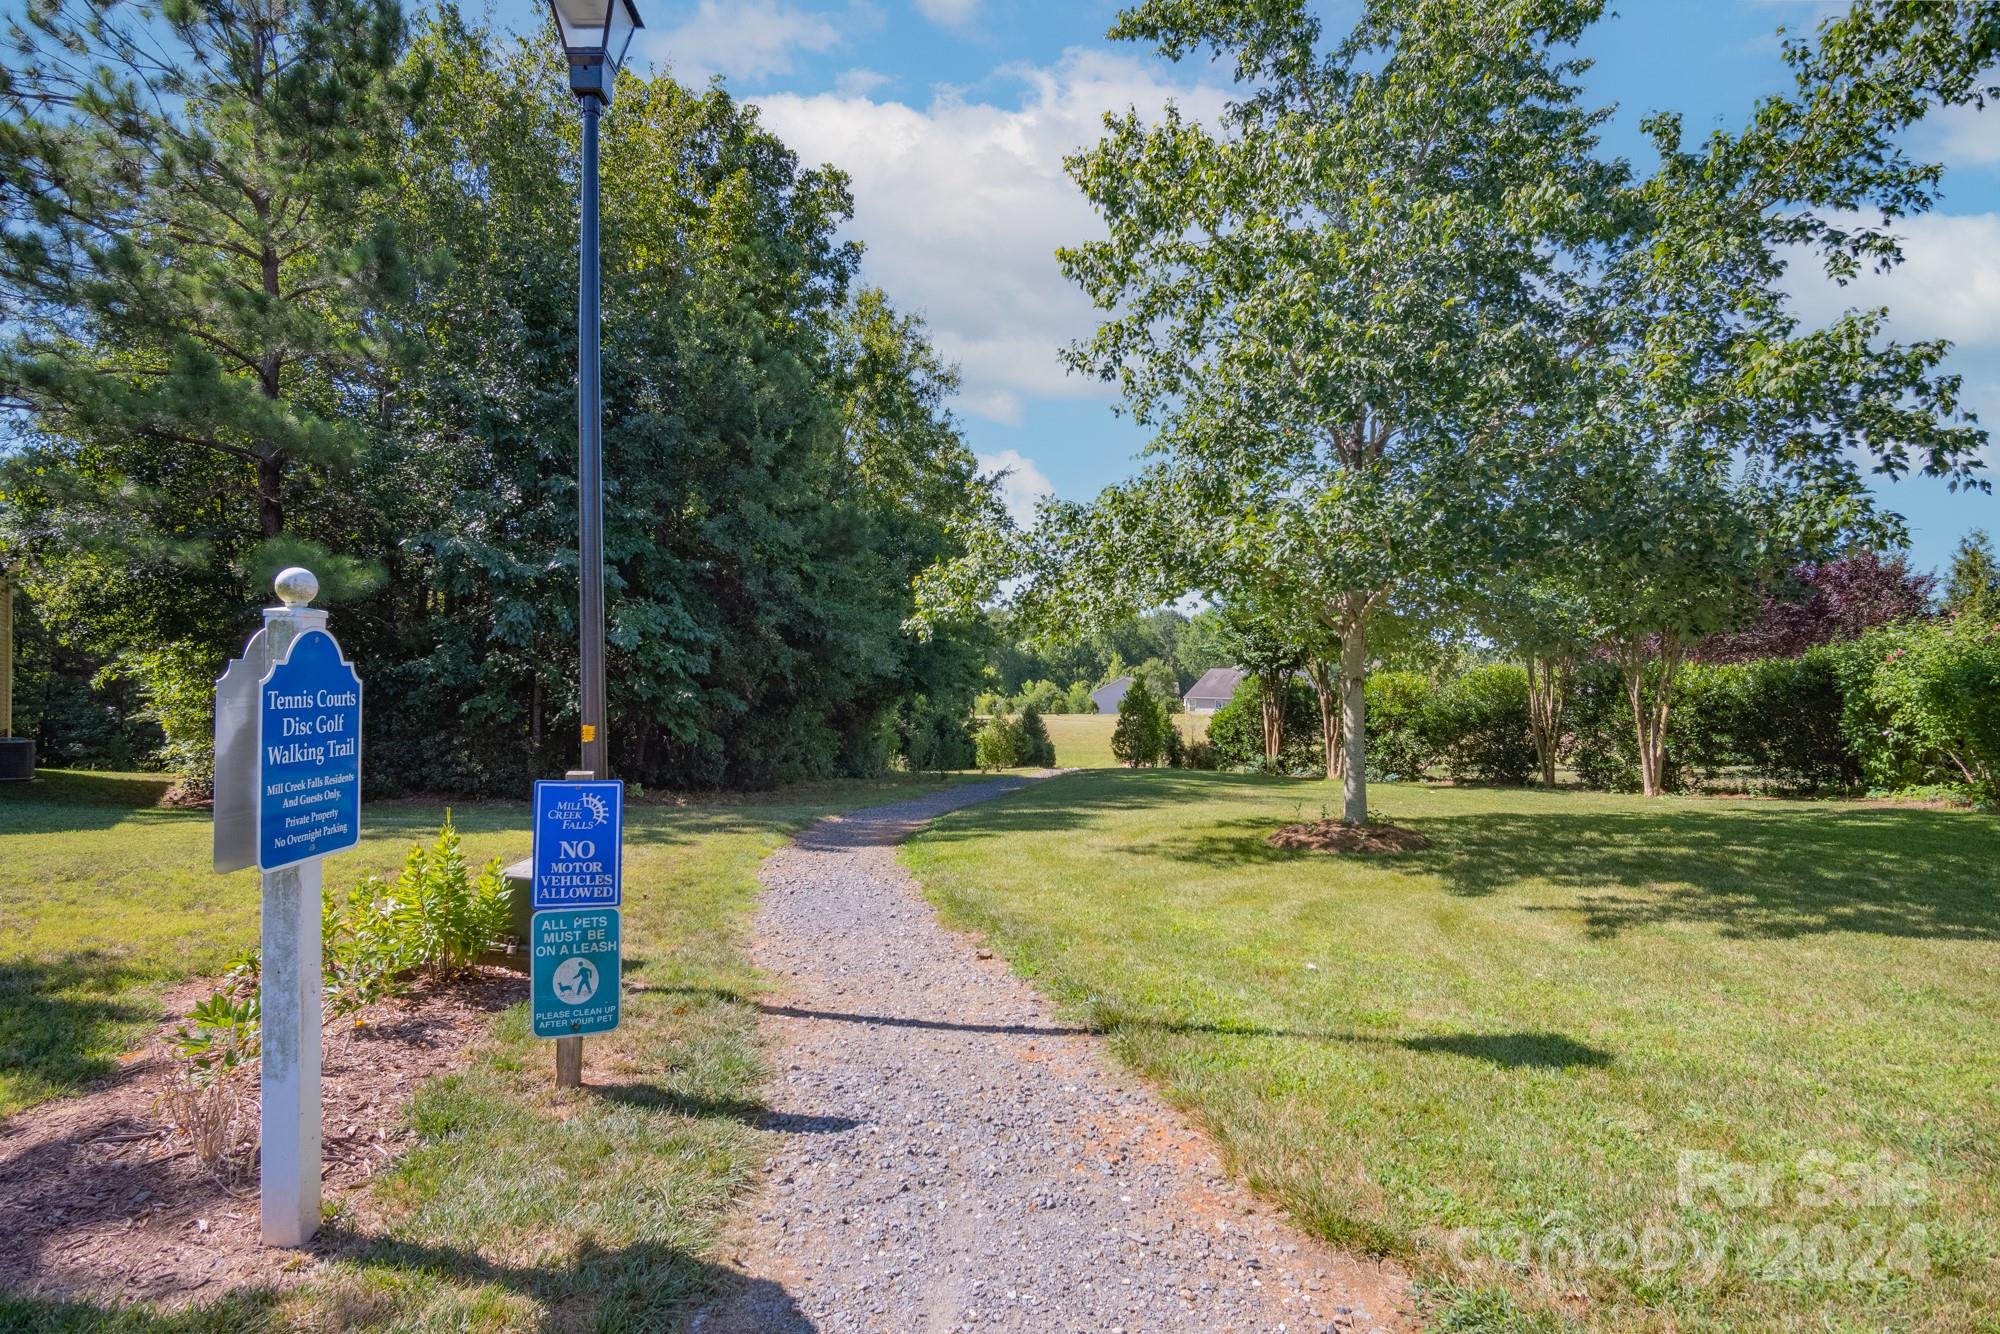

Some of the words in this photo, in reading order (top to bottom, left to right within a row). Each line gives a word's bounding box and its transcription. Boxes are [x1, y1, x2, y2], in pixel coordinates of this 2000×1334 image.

[267, 689, 313, 710] Tennis
[317, 689, 356, 707] Courts
[282, 716, 312, 736] Disc
[316, 714, 344, 733] Golf
[267, 742, 325, 766] Walking
[327, 737, 354, 758] Trail
[267, 783, 284, 796] Mill
[285, 780, 306, 792] Creek
[307, 777, 323, 789] Falls
[325, 773, 354, 784] Residents
[282, 796, 298, 808] And
[300, 793, 323, 804] Guests
[557, 801, 582, 810] MILL
[285, 815, 309, 828] Private
[311, 809, 339, 822] Property
[548, 810, 583, 819] CREEK
[562, 820, 595, 829] FALLS
[274, 838, 285, 848] No
[287, 828, 322, 845] Overnight
[323, 823, 348, 836] Parking
[559, 840, 595, 859] NO
[551, 862, 602, 873] MOTOR
[540, 874, 613, 886] VEHICLES
[540, 887, 613, 898] ALLOWED
[542, 920, 567, 931] ALL
[574, 916, 607, 928] PETS
[544, 931, 581, 943] MUST
[588, 929, 606, 940] BE
[536, 946, 556, 957] ON
[560, 944, 569, 955] A
[573, 941, 617, 954] LEASH
[536, 1011, 571, 1020] PLEASE
[573, 1008, 602, 1017] CLEAN
[604, 1006, 616, 1014] UP
[539, 1020, 568, 1028] AFTER
[570, 1017, 594, 1025] YOUR
[597, 1014, 613, 1023] PET
